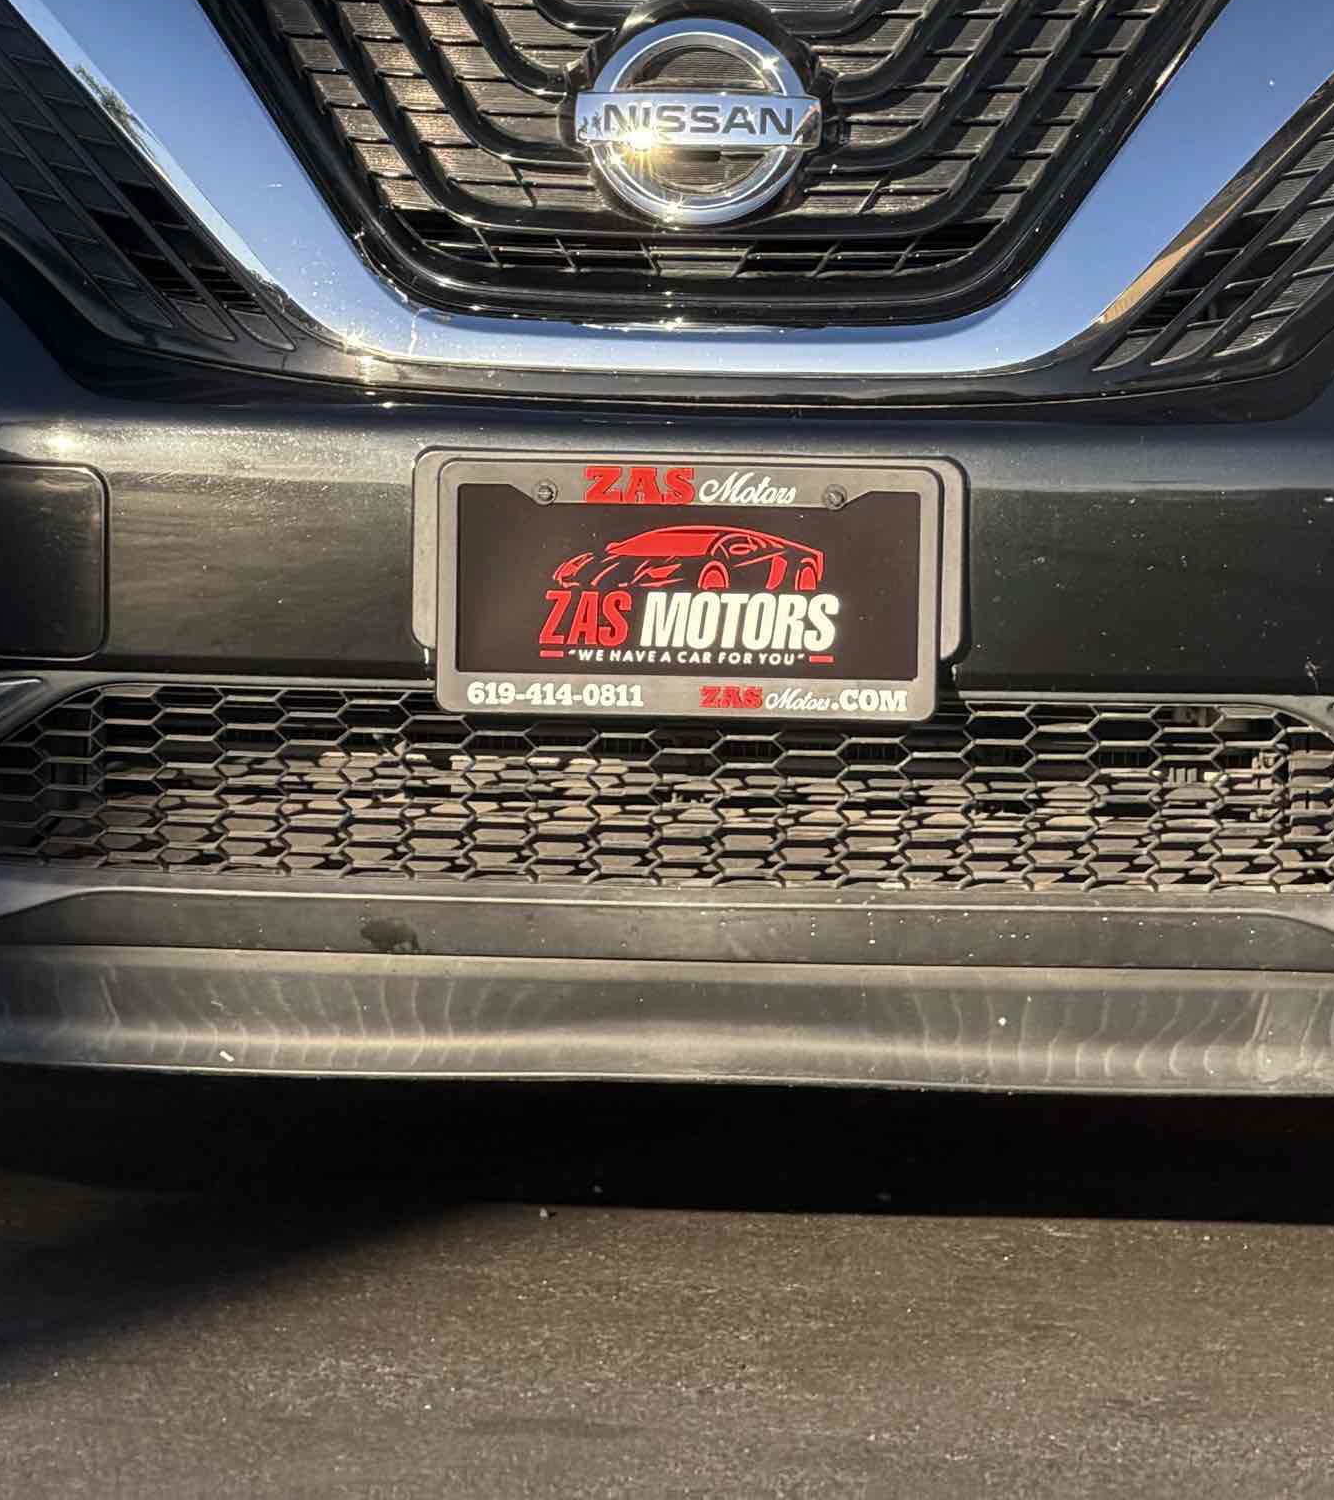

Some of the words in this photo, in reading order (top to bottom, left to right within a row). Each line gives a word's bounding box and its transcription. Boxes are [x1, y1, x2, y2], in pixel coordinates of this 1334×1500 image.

[603, 103, 794, 136] NISSAN
[584, 465, 696, 504] ZAS
[698, 470, 797, 504] Motors
[538, 589, 633, 647] ZAS
[638, 591, 840, 652] MOTORS
[609, 649, 656, 664] HAVE
[659, 651, 673, 664] A
[677, 650, 712, 665] CAR
[717, 651, 753, 665] FOR
[466, 680, 645, 708] 619-414-0811
[698, 685, 764, 709] ZAS
